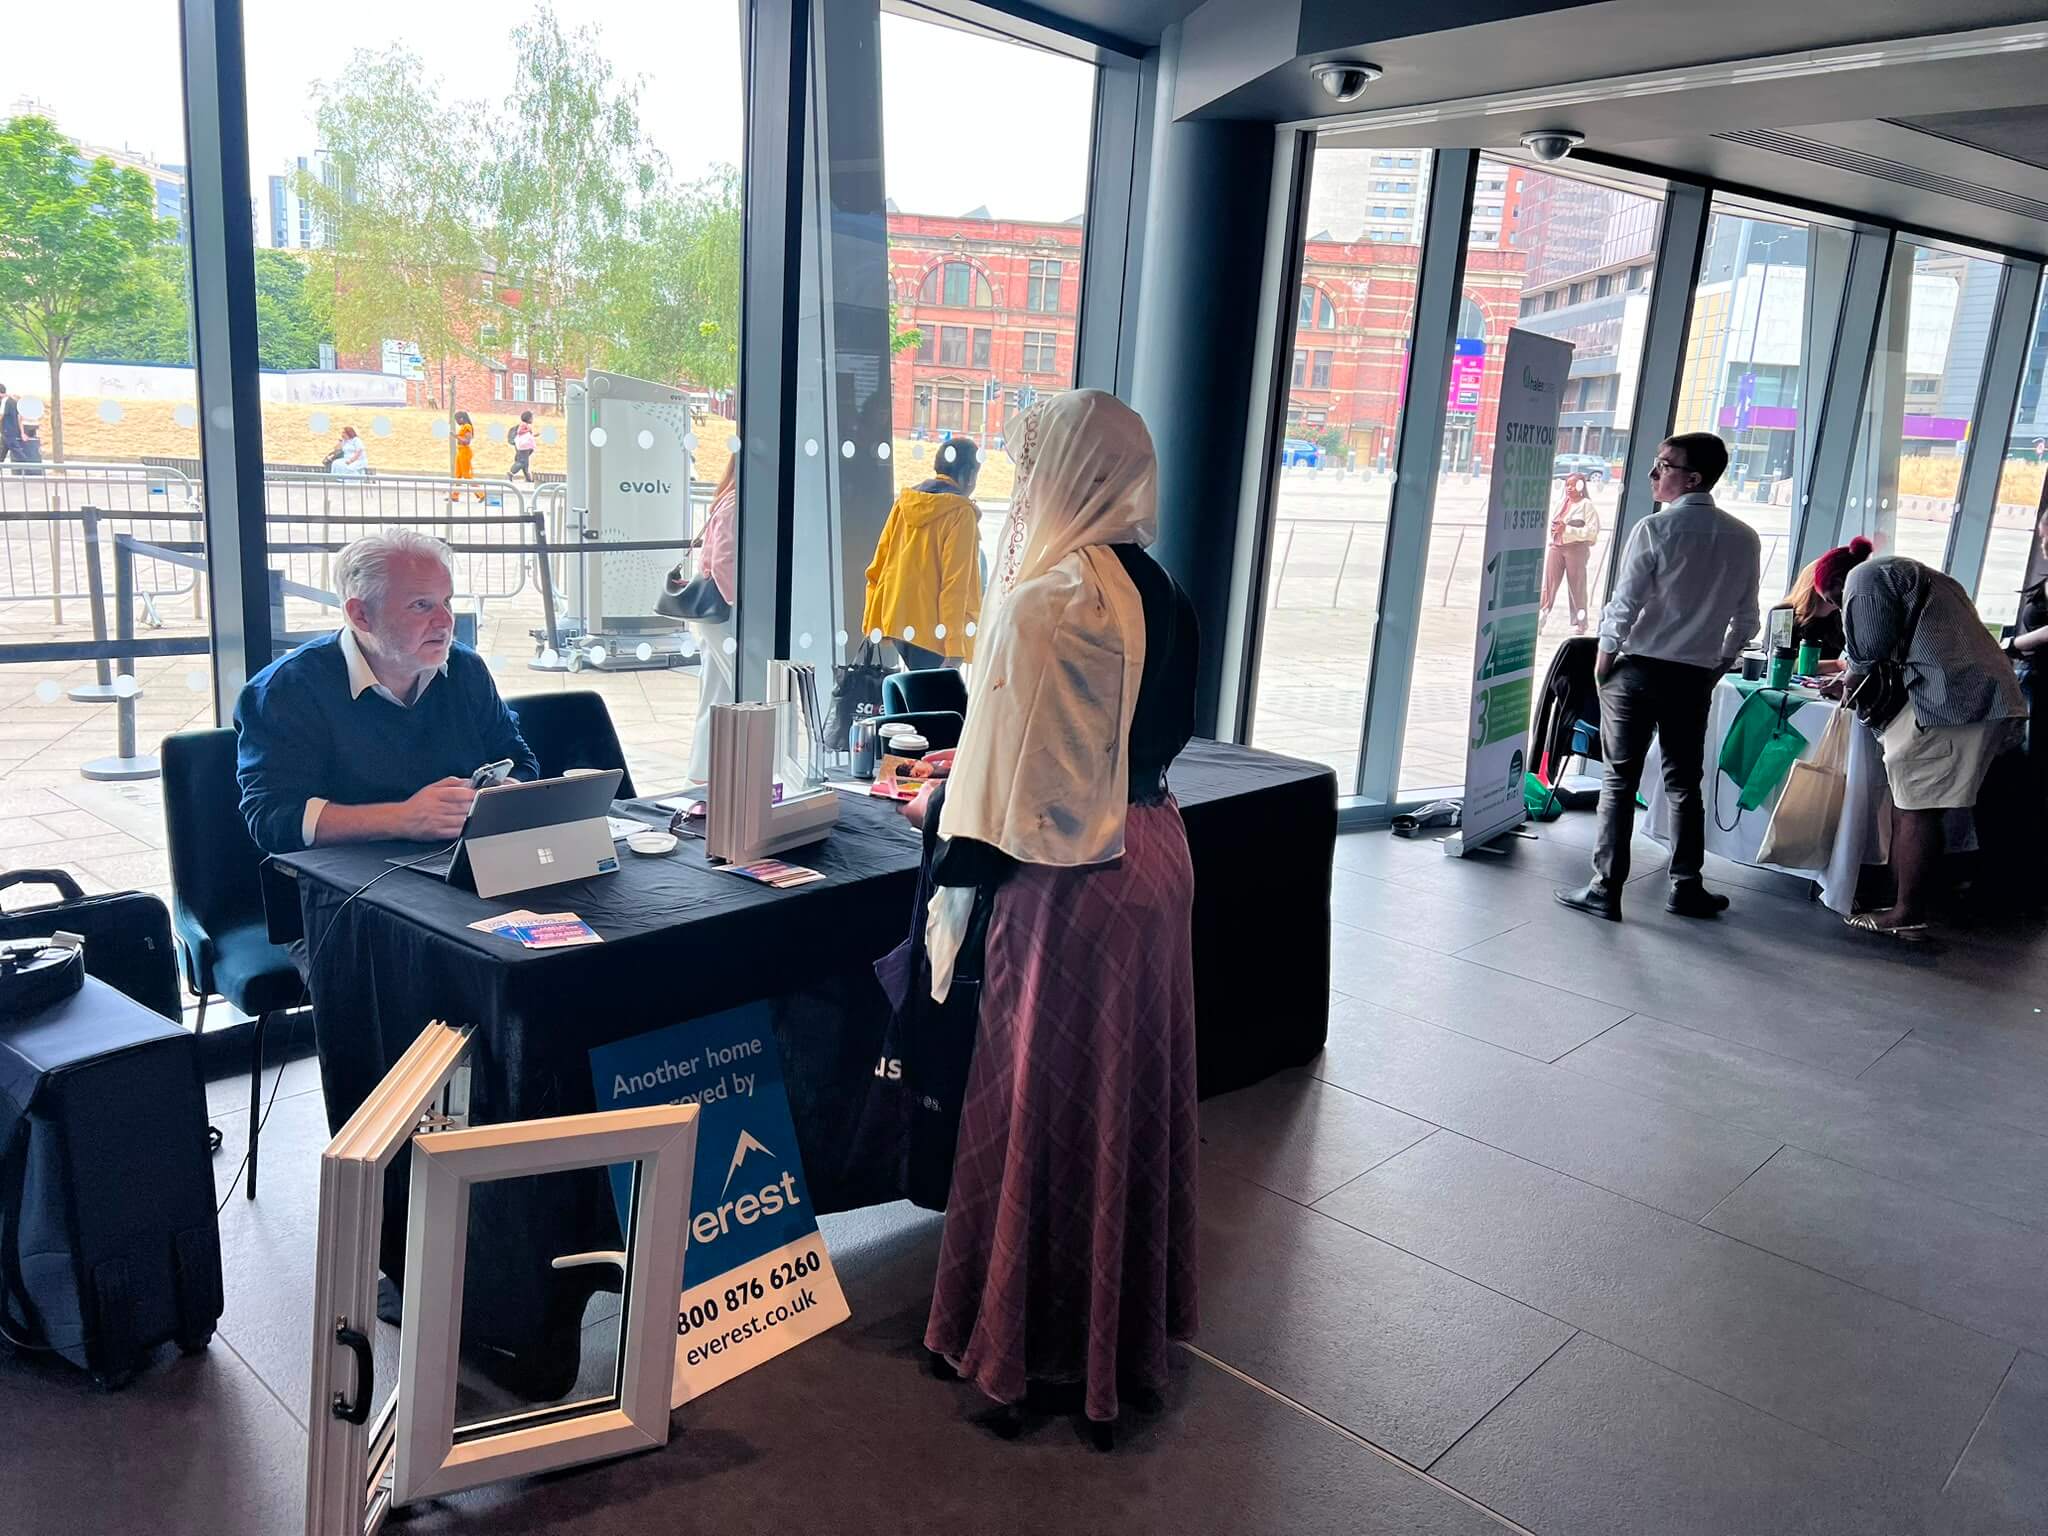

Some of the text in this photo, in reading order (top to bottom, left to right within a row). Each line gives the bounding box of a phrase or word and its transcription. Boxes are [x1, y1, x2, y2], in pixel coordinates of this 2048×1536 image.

[1506, 421, 1536, 444] START
[1502, 478, 1550, 509] CAREE
[612, 1038, 763, 1100] Another home
[732, 1072, 756, 1097] by
[685, 1170, 800, 1250] erest
[724, 1277, 764, 1312] 876
[770, 1250, 821, 1290] 6260
[686, 1287, 818, 1366] everest.co.uk
